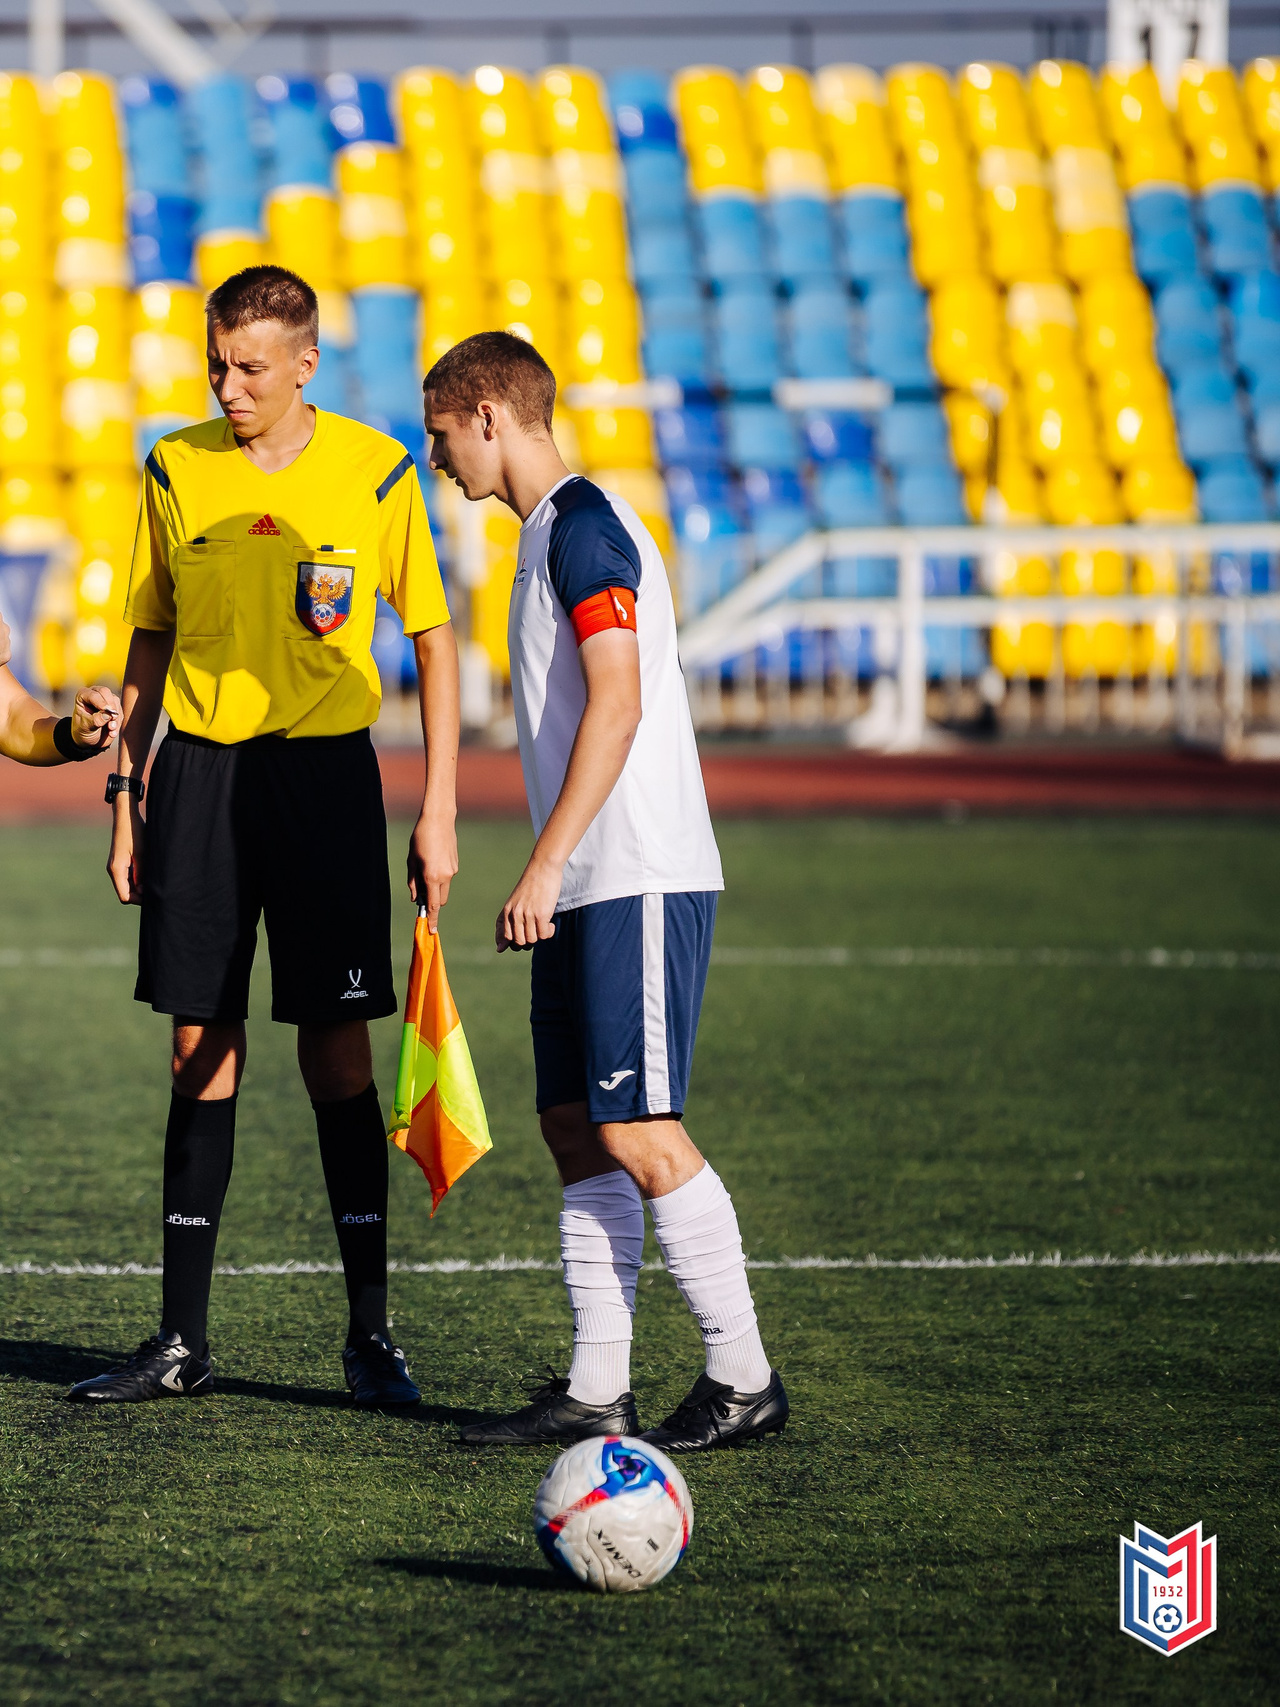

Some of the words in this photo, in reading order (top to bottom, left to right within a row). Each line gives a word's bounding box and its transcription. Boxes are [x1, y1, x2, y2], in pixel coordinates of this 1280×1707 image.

[247, 526, 281, 536] adidas
[165, 1213, 211, 1226] JÖGEL
[339, 1213, 382, 1224] JÖGEL
[593, 1528, 642, 1579] DEMIX
